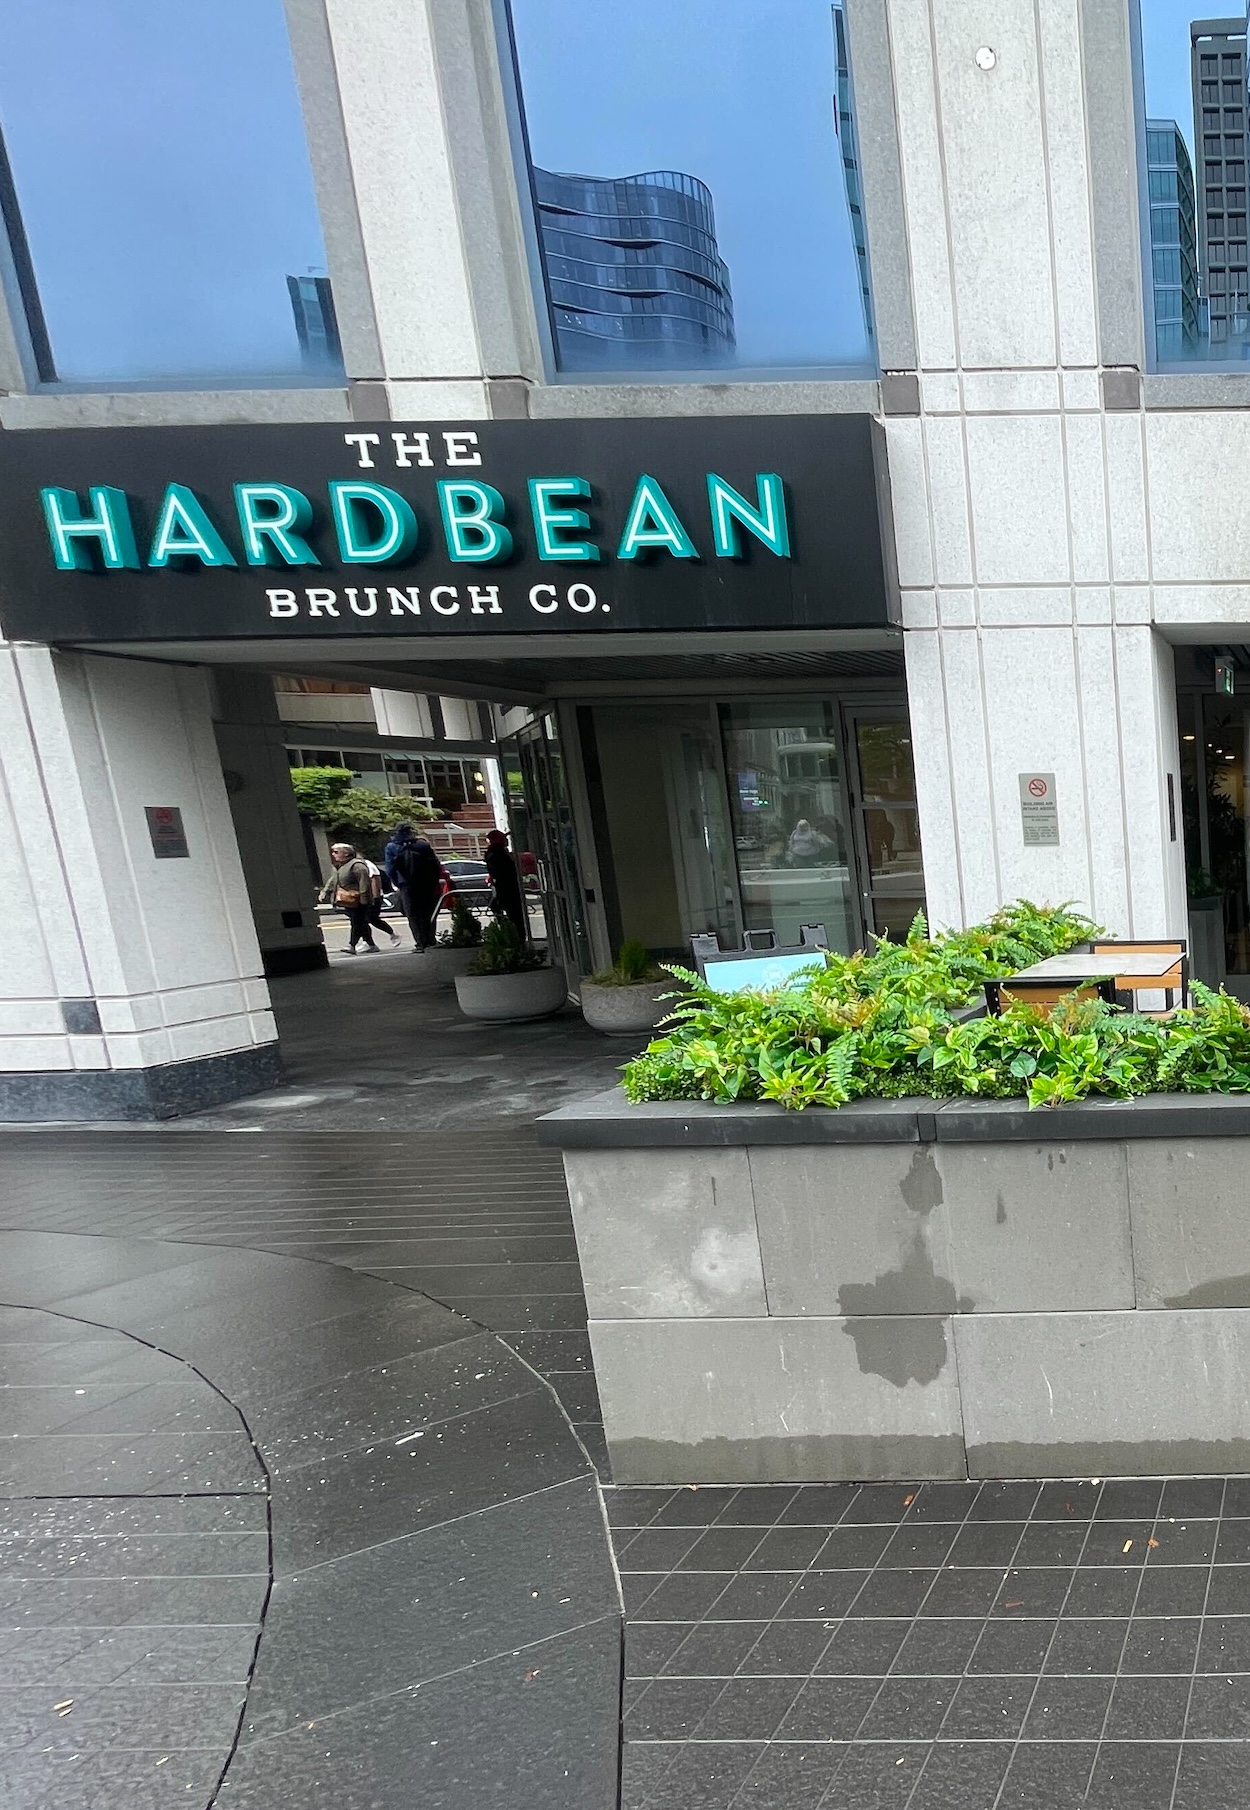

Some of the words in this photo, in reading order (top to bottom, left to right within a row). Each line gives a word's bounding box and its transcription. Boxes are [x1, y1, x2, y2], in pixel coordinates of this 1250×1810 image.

[344, 432, 482, 468] THE
[41, 472, 791, 570] HARDBEAN
[266, 585, 503, 617] BRUNCH
[529, 583, 611, 615] CO.
